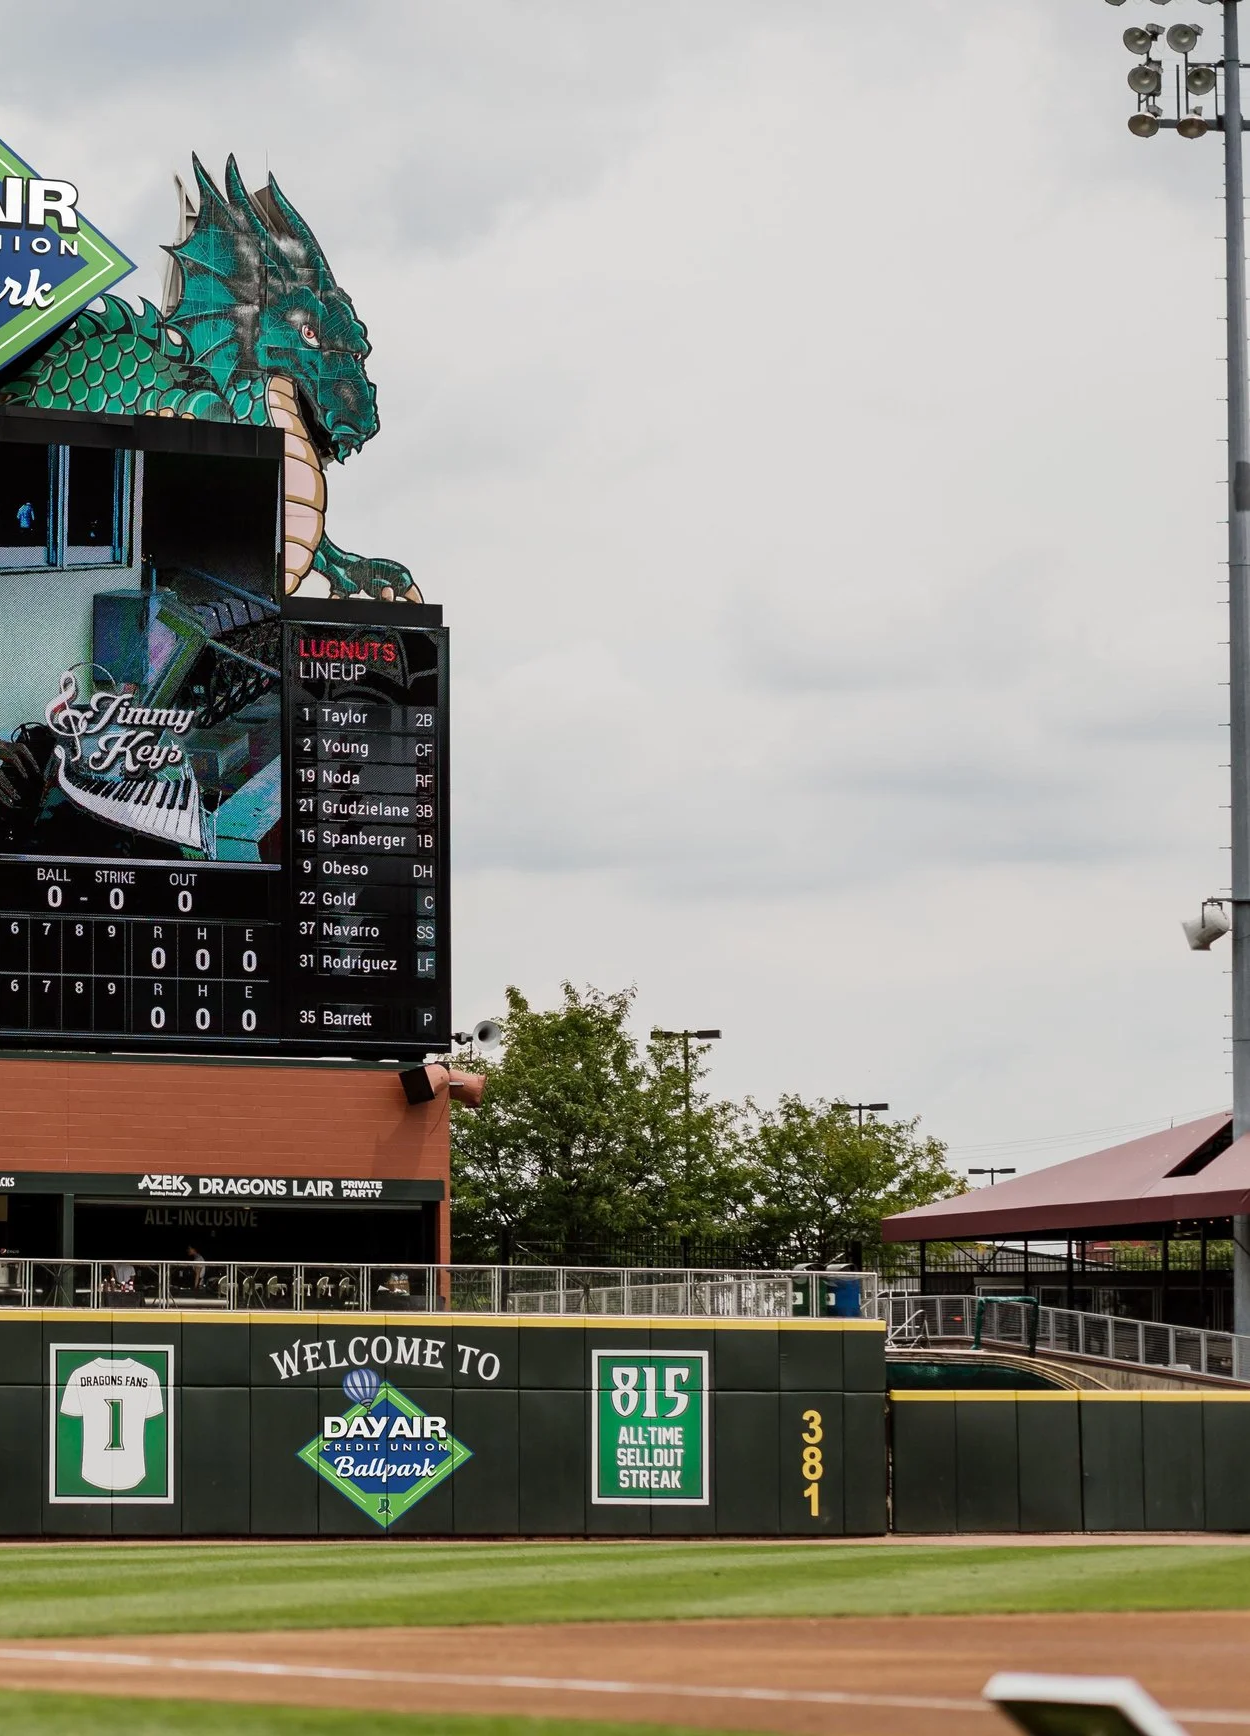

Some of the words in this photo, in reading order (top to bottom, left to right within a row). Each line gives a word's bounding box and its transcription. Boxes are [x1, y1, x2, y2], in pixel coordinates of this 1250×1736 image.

[300, 640, 395, 661] LUGNUTS
[300, 662, 366, 680] LINEUP
[84, 692, 194, 734] Jimmy
[304, 708, 308, 720] 1
[322, 709, 367, 725] Taylor
[416, 714, 432, 726] 2B
[89, 731, 182, 772] Keys
[304, 739, 310, 751] 2
[323, 739, 368, 757] Young
[415, 744, 432, 756] CF
[300, 769, 315, 782] 19
[323, 770, 359, 784] Noda
[416, 775, 432, 787] RF
[300, 799, 312, 811] 21
[323, 801, 409, 816] Grudzielane
[416, 805, 432, 817] 3B
[300, 830, 315, 842] 16
[323, 831, 406, 849] Spanberger
[418, 835, 432, 847] 1B
[38, 868, 70, 881] BALL
[96, 871, 135, 883] STRIKE
[170, 873, 197, 885] OUT
[304, 861, 311, 872] 9
[323, 861, 368, 875] Obeso
[414, 865, 432, 877] DH
[48, 886, 62, 907] 0
[110, 888, 123, 909] 0
[178, 891, 192, 912] 0
[300, 892, 315, 904] 22
[323, 892, 355, 905] Gold
[425, 896, 433, 909] C
[11, 922, 18, 933] 6
[43, 923, 51, 935] 7
[76, 924, 83, 936] 8
[108, 926, 115, 937] 9
[154, 926, 162, 938] R
[198, 928, 206, 939] H
[246, 929, 253, 941] E
[300, 922, 315, 934] 37
[324, 923, 379, 937] Navarro
[417, 926, 434, 939] SS
[152, 947, 165, 969] 0
[196, 949, 209, 970] 0
[243, 951, 256, 971] 0
[300, 955, 313, 967] 31
[324, 955, 396, 972] Rodriguez
[418, 959, 433, 971] LF
[11, 980, 18, 991] 6
[43, 981, 50, 992] 7
[76, 982, 83, 993] 8
[108, 983, 115, 994] 9
[154, 983, 162, 995] R
[199, 985, 207, 996] H
[246, 986, 252, 998] E
[151, 1007, 165, 1028] 0
[196, 1008, 210, 1029] 0
[242, 1010, 256, 1031] 0
[300, 1011, 315, 1023] 35
[324, 1011, 371, 1025] Barrett
[424, 1014, 432, 1025] P
[138, 1175, 185, 1191] AZEK
[198, 1177, 287, 1196] DRAGONS
[292, 1180, 333, 1197] LAIR
[341, 1180, 383, 1190] PRIVATE
[342, 1189, 382, 1198] PARTY
[145, 1209, 258, 1227] ALL-INCLUSIVE
[269, 1335, 446, 1380] WELCOME
[457, 1344, 500, 1381] TO
[80, 1375, 122, 1388] DRAGONS
[125, 1376, 148, 1389] FANS
[610, 1365, 691, 1419] 815
[104, 1399, 124, 1451] 1
[323, 1415, 388, 1440] DAY
[387, 1415, 446, 1440] AIR
[618, 1426, 683, 1446] ALL-TIME
[323, 1442, 381, 1452] CREDIT
[390, 1442, 448, 1452] UNION
[616, 1448, 684, 1468] SELLOUT
[335, 1455, 436, 1484] Ballpark
[619, 1469, 681, 1490] STREAK
